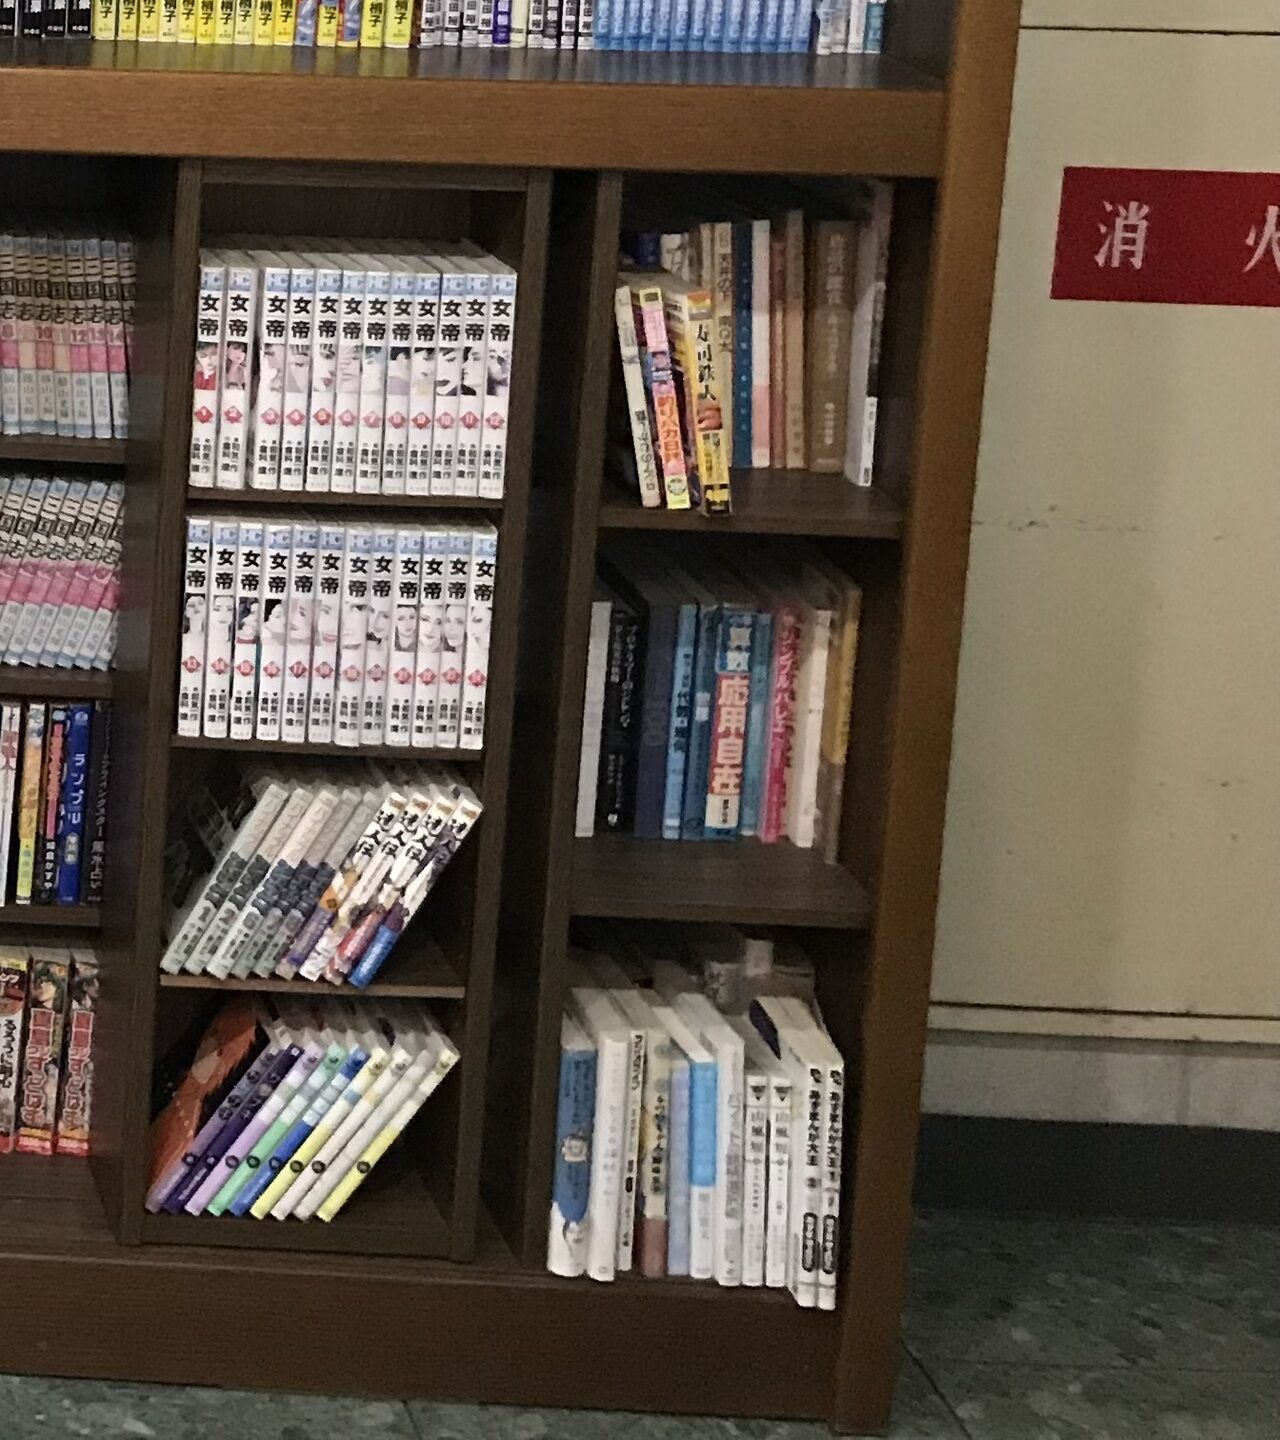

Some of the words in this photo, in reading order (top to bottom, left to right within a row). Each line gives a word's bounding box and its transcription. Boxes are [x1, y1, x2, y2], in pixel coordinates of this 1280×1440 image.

[200, 295, 220, 335] 女帝
[229, 295, 249, 336] 女帝
[266, 296, 286, 337] 女帝
[291, 297, 311, 338] 女帝
[318, 296, 338, 338] 女帝
[343, 298, 362, 339] 女帝
[367, 298, 387, 340] 女帝
[392, 299, 412, 340] 女帝
[416, 299, 436, 340] 女帝
[441, 300, 461, 341] 女帝
[465, 299, 485, 340] 女帝
[490, 300, 512, 341] 女帝
[188, 546, 206, 588] 女帝
[215, 548, 234, 589] 女帝
[241, 550, 260, 591] 女帝
[268, 553, 287, 593] 女帝
[295, 552, 314, 593] 女帝
[321, 553, 340, 594] 女帝
[349, 557, 368, 597] 女帝
[372, 556, 392, 597] 女帝
[399, 558, 419, 599] 女帝
[424, 558, 443, 599] 女帝
[448, 558, 468, 599] 女帝
[474, 560, 494, 601] 女帝
